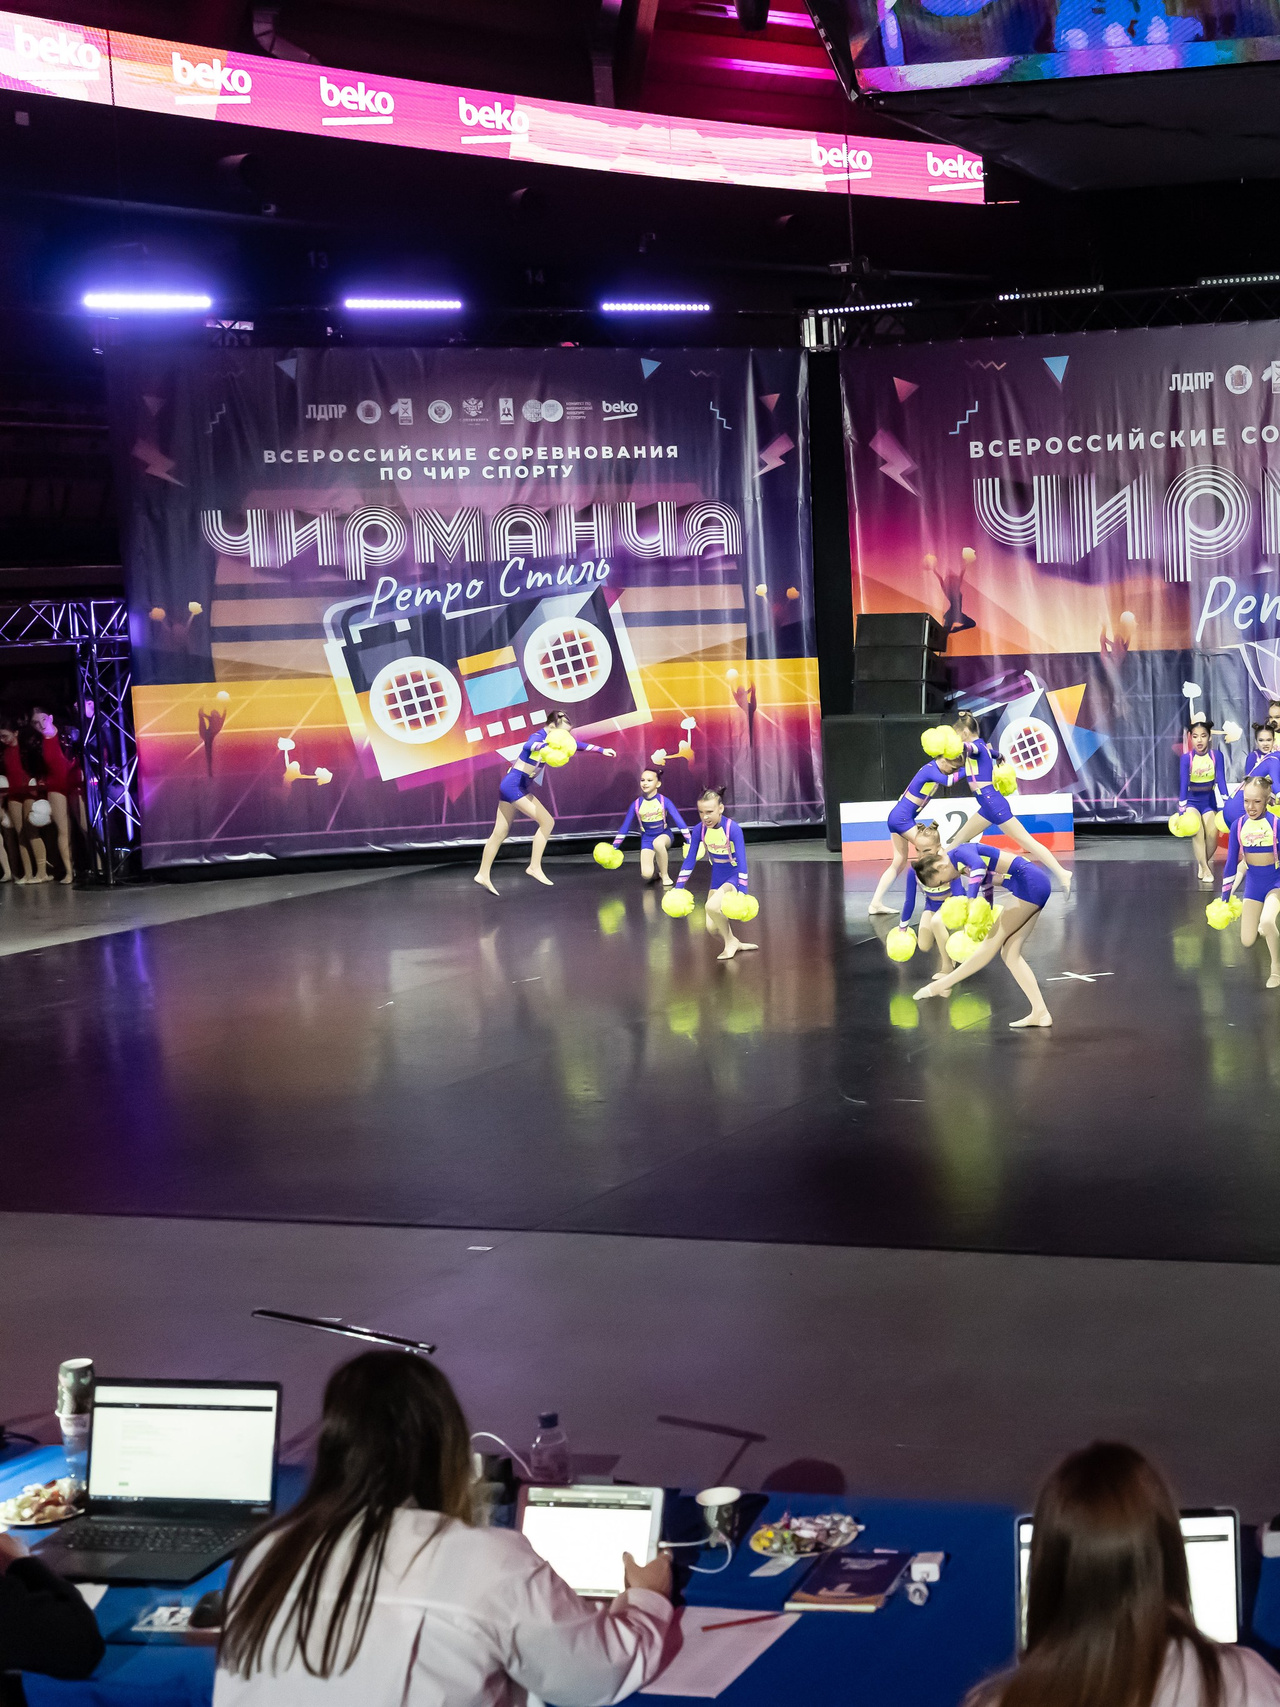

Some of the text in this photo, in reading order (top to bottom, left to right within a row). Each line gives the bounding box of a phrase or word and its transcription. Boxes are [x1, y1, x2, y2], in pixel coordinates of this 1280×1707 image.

[14, 24, 99, 69] beko
[172, 52, 252, 94] beko
[319, 75, 395, 115] beko
[458, 97, 530, 133] beko
[811, 138, 873, 171] beko
[1168, 372, 1215, 393] ЛДПР
[305, 404, 347, 421] ЛДПР
[602, 400, 638, 413] beko
[263, 445, 678, 463] ВСЕРОССИЙСКИЕ СОРЕВНОВАНИЯ
[969, 427, 1226, 458] ВСЕРОССИЙСКИЕ
[380, 464, 574, 481] ПО ЧИР СПОРТУ
[369, 556, 611, 619] Ретро Стиль
[945, 810, 970, 845] 2
